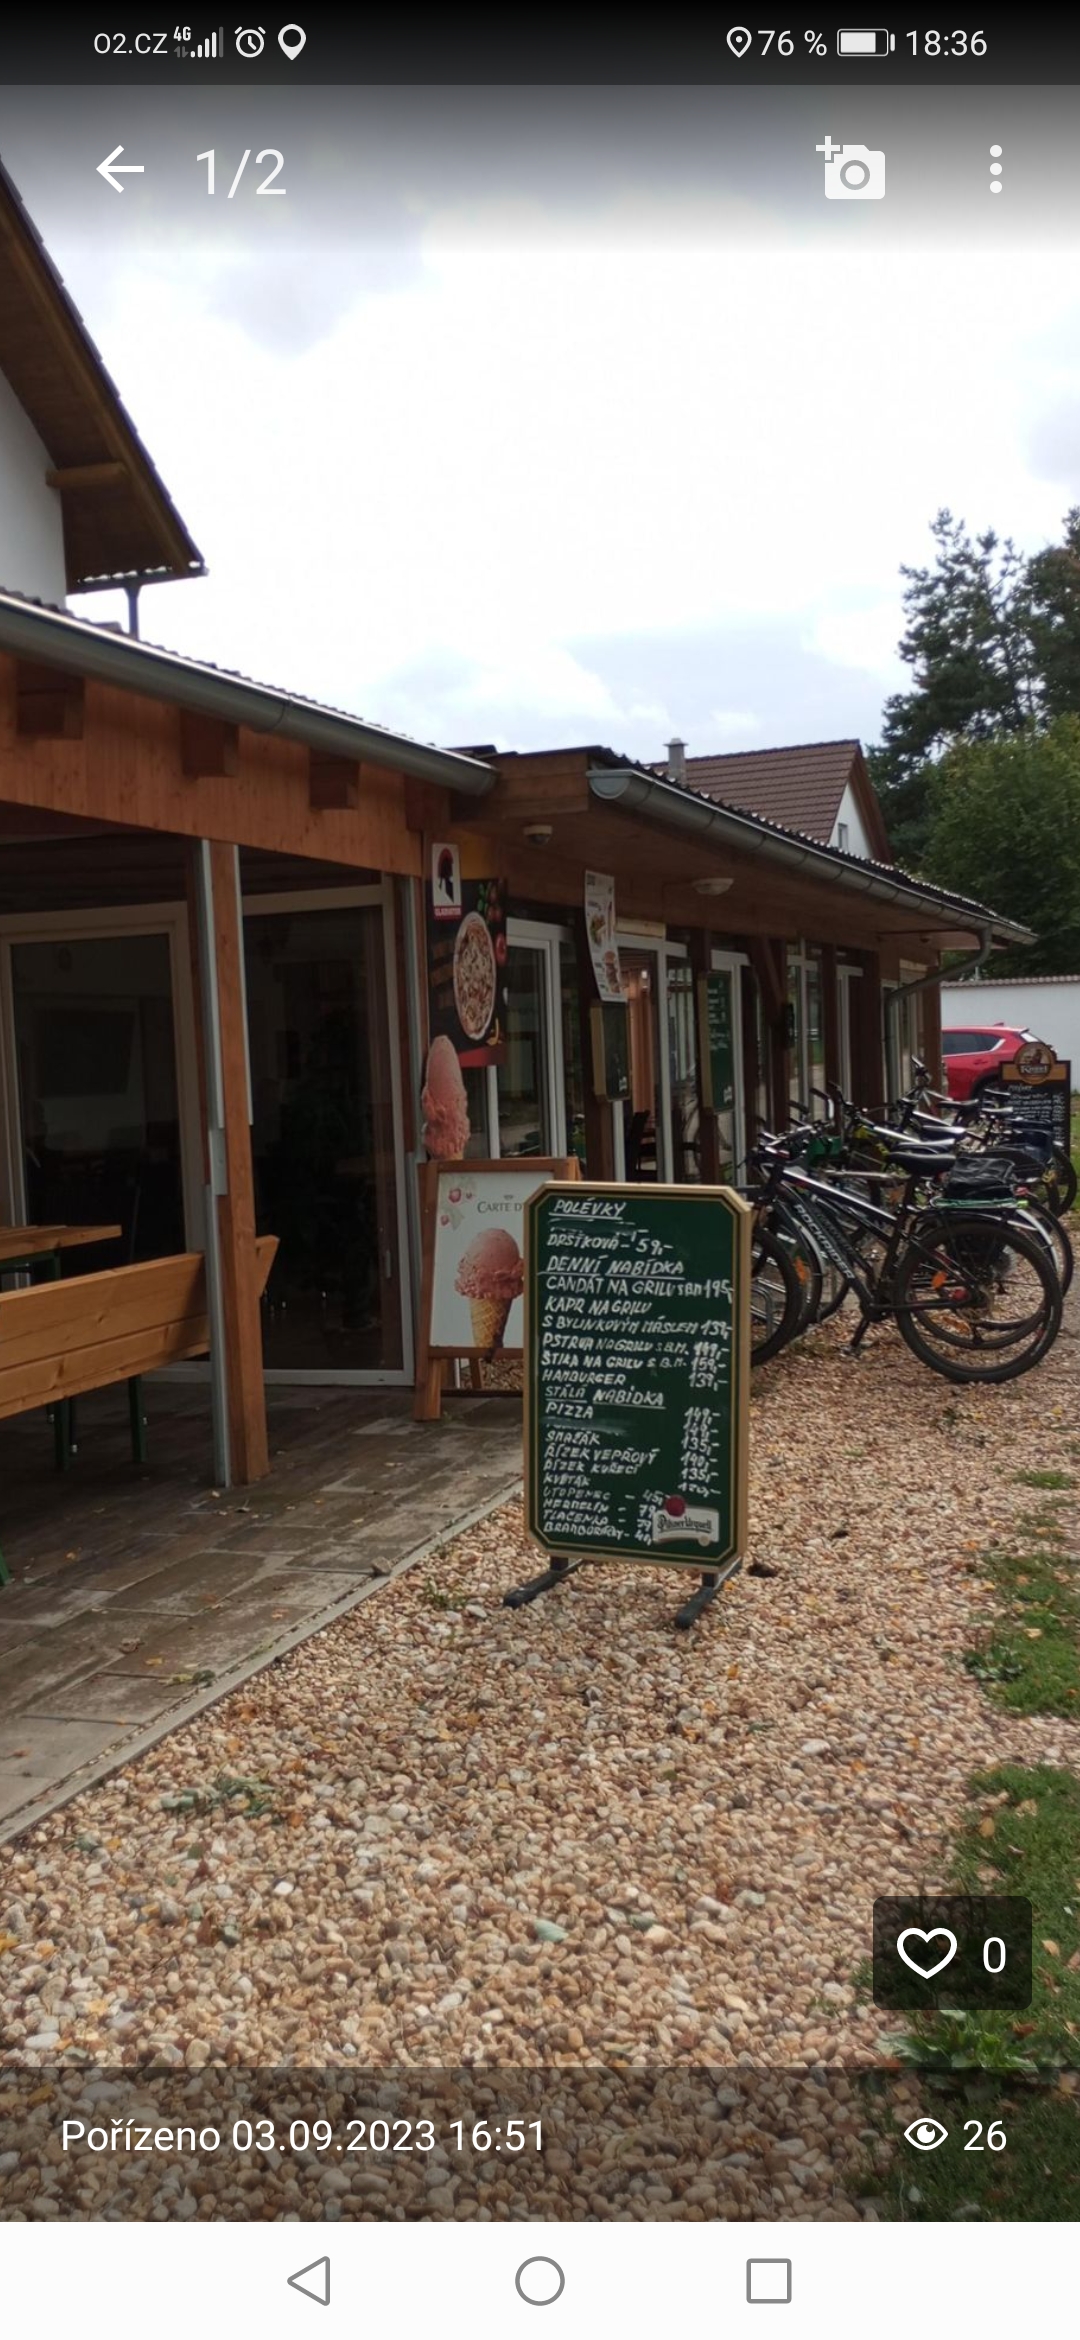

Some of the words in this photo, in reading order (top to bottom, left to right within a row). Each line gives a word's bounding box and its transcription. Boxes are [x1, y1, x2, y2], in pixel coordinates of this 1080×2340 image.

[554, 1197, 626, 1217] POLÉVKY
[547, 1255, 608, 1274] DENNÍ
[607, 1259, 685, 1276] NABÍDKA
[546, 1275, 604, 1294] CANDÁT
[607, 1279, 628, 1296] NA
[632, 1281, 677, 1297] GRILU
[545, 1296, 585, 1314] KAPR
[588, 1300, 608, 1315] NA
[611, 1299, 653, 1316] GRILU
[542, 1315, 553, 1328] S
[641, 1315, 699, 1335] MÁSLEM
[583, 1355, 602, 1368] NA
[541, 1370, 627, 1386] HAMBURGER
[593, 1386, 665, 1406] NABÍDKA
[545, 1402, 594, 1419] PIZZA
[543, 1486, 611, 1500] UTOPENEC
